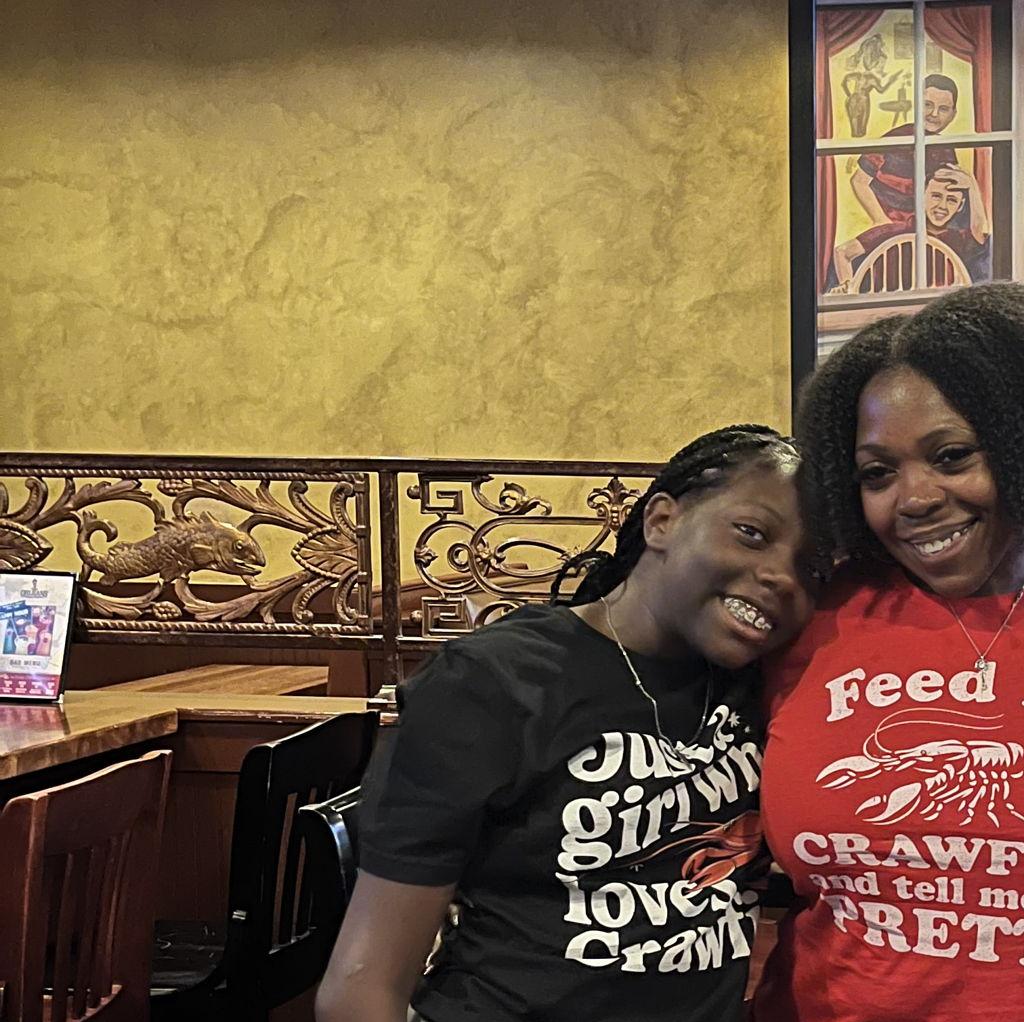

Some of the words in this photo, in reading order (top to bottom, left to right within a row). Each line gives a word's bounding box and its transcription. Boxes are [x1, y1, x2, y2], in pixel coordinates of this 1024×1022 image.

[824, 661, 997, 723] Feed
[557, 782, 692, 872] girl
[808, 871, 881, 897] and
[892, 876, 966, 905] tell
